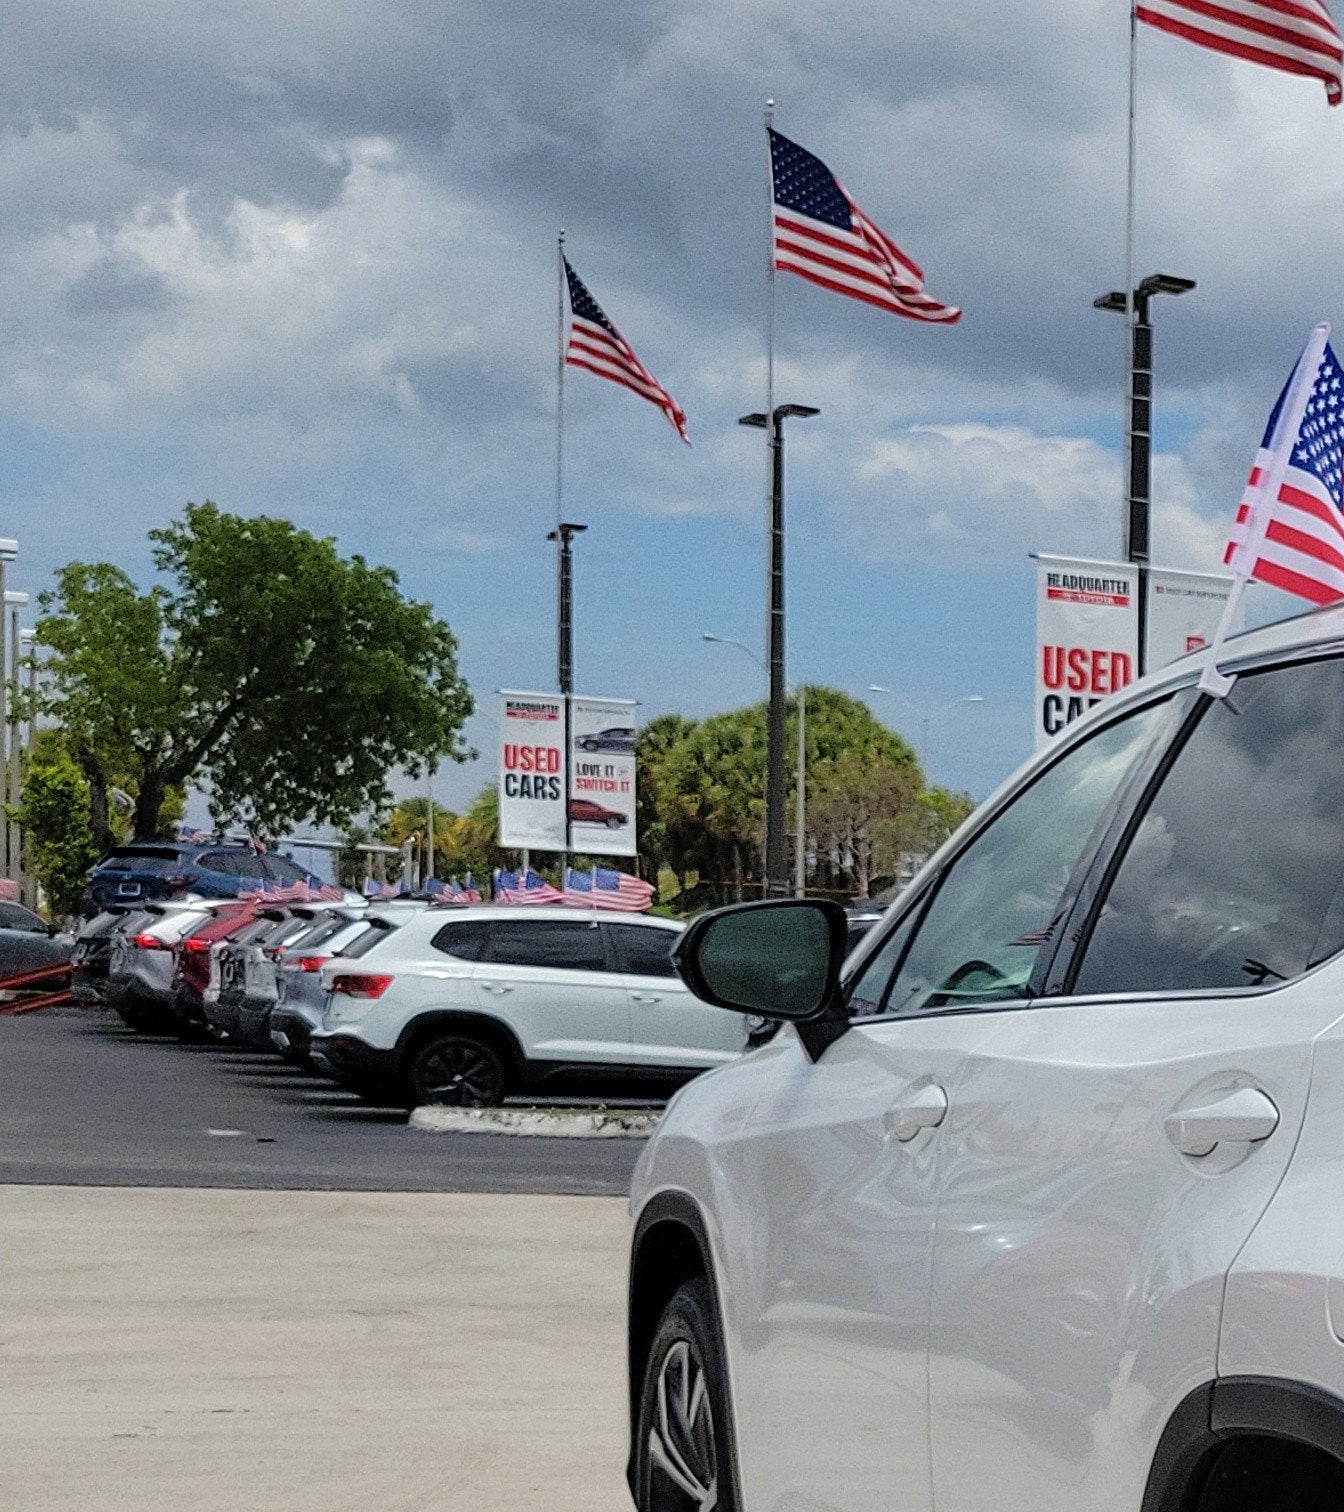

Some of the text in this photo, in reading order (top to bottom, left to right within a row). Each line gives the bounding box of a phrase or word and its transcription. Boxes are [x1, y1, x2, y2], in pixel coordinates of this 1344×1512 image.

[1047, 573, 1130, 595] HEADQUARTER
[1043, 646, 1132, 695] USED
[1043, 694, 1104, 736] CA
[504, 744, 560, 773] USED
[576, 762, 615, 778] LOVE IT
[505, 774, 561, 800] CARS
[575, 778, 630, 793] SWITCH IT
